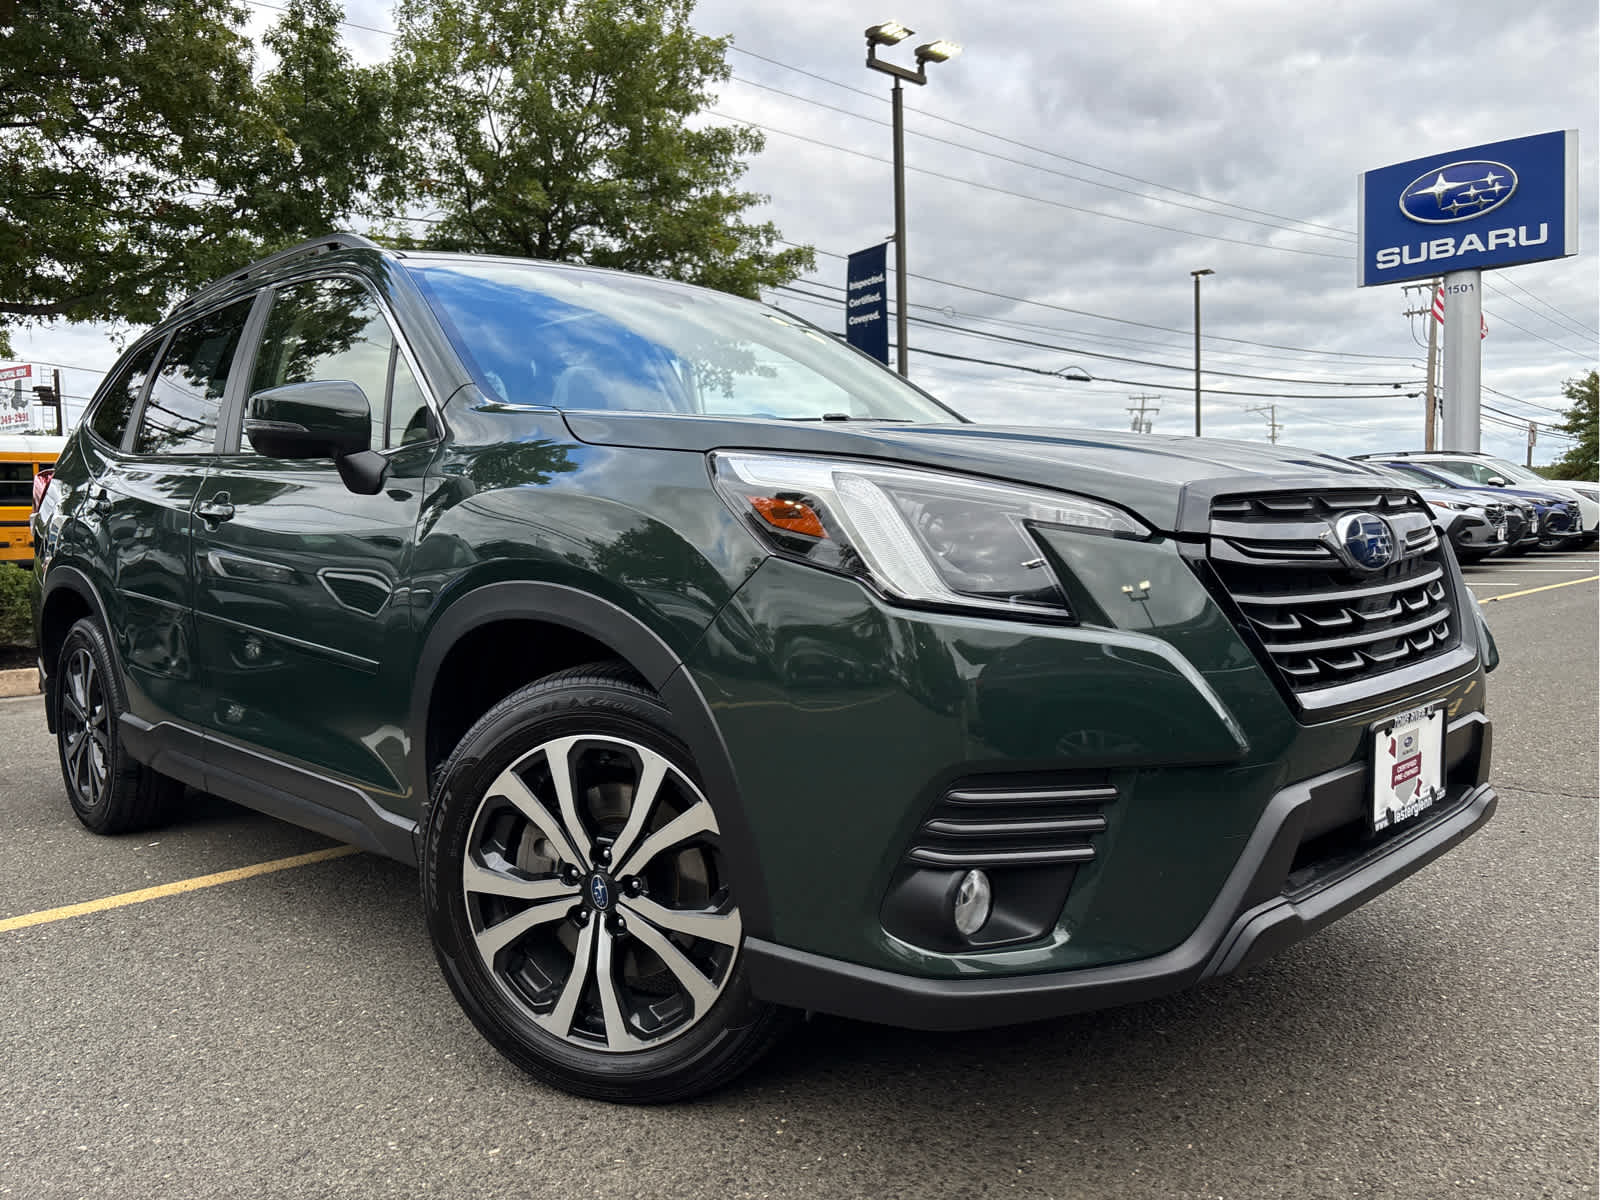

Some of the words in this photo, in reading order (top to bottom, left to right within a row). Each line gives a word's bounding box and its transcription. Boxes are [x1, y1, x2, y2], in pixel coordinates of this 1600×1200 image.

[1376, 223, 1548, 270] SUBARU
[849, 273, 885, 291] Inspected.
[1447, 283, 1475, 295] 1501
[848, 292, 882, 308] Certified.
[848, 310, 881, 326] Covered.
